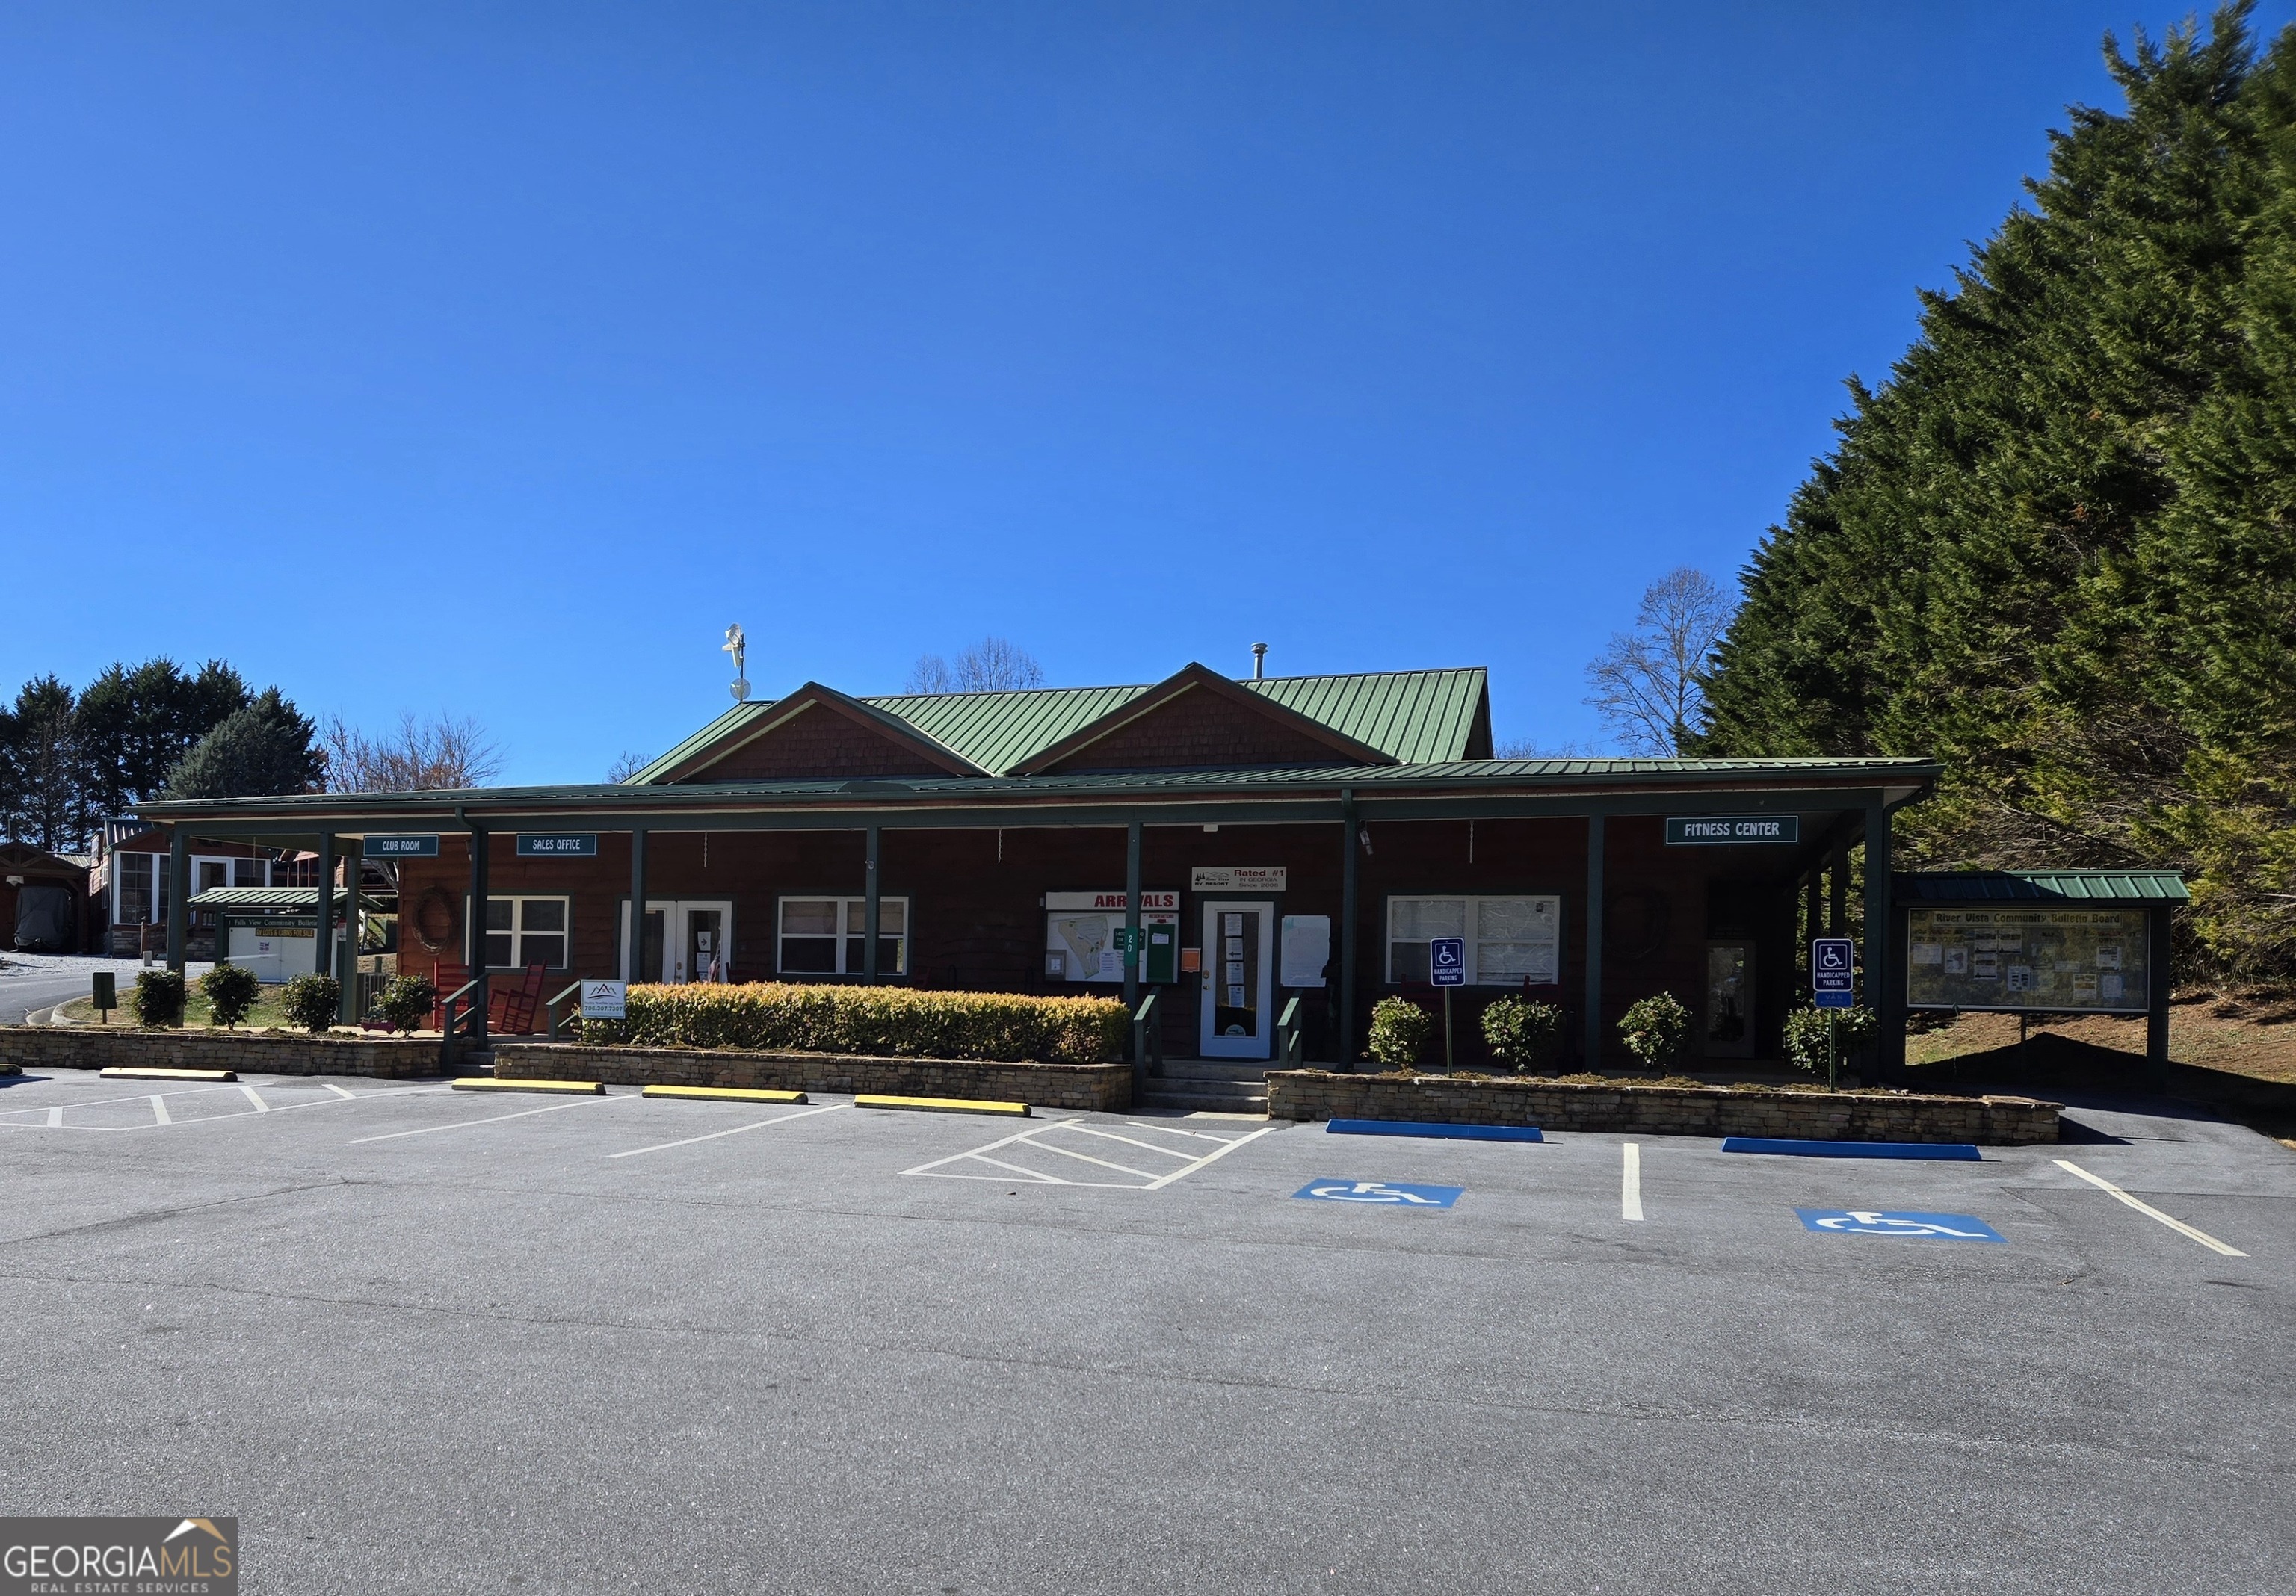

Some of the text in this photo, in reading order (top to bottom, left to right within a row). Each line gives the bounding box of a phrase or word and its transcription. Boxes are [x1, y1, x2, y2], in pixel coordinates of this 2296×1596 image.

[1685, 822, 1780, 836] FITNESS CENTER
[382, 841, 420, 851] CLUB ROOM
[532, 839, 580, 850] SALES OFFICE
[1234, 869, 1266, 877] Rated
[1094, 894, 1174, 907] ARRALS
[264, 919, 295, 927] Community
[1936, 913, 2120, 924] River Vista Community Bulletin Board
